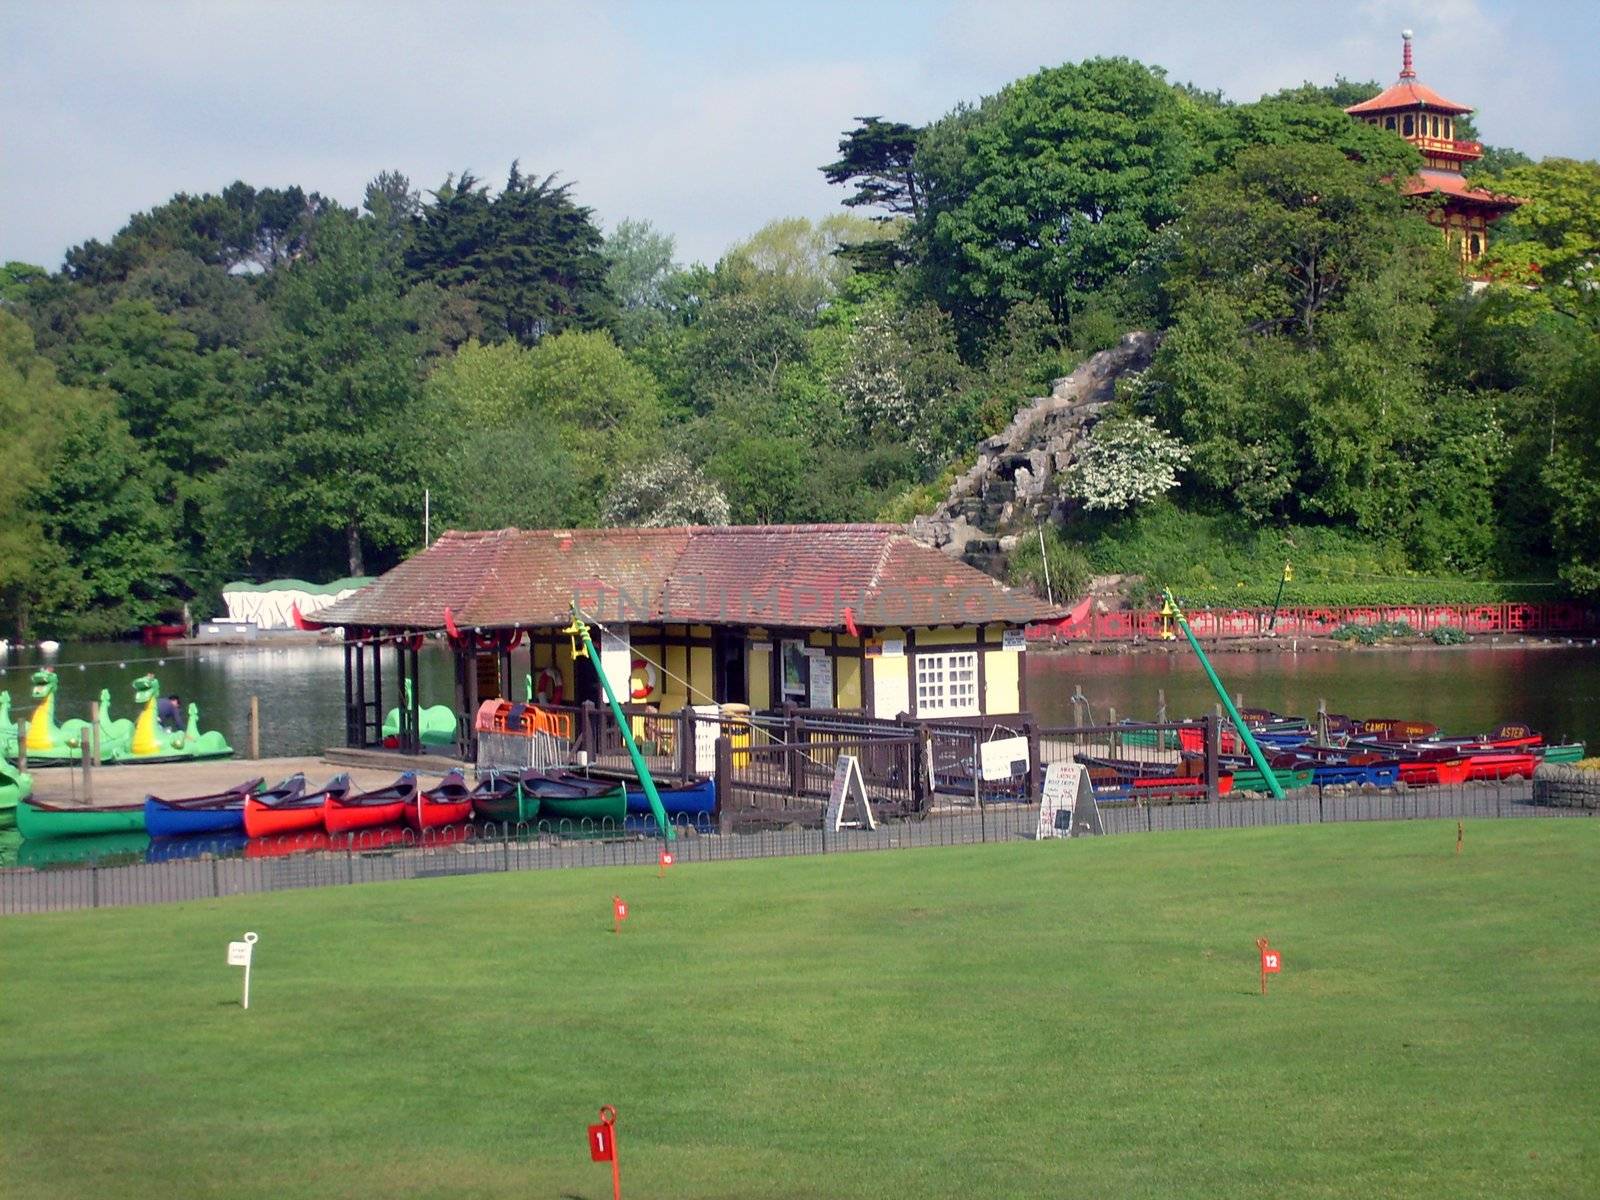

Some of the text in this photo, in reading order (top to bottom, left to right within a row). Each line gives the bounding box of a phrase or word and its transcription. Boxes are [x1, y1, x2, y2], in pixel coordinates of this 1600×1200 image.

[1500, 726, 1525, 738] ASTER
[1265, 955, 1278, 968] 12
[596, 1131, 604, 1153] 1
